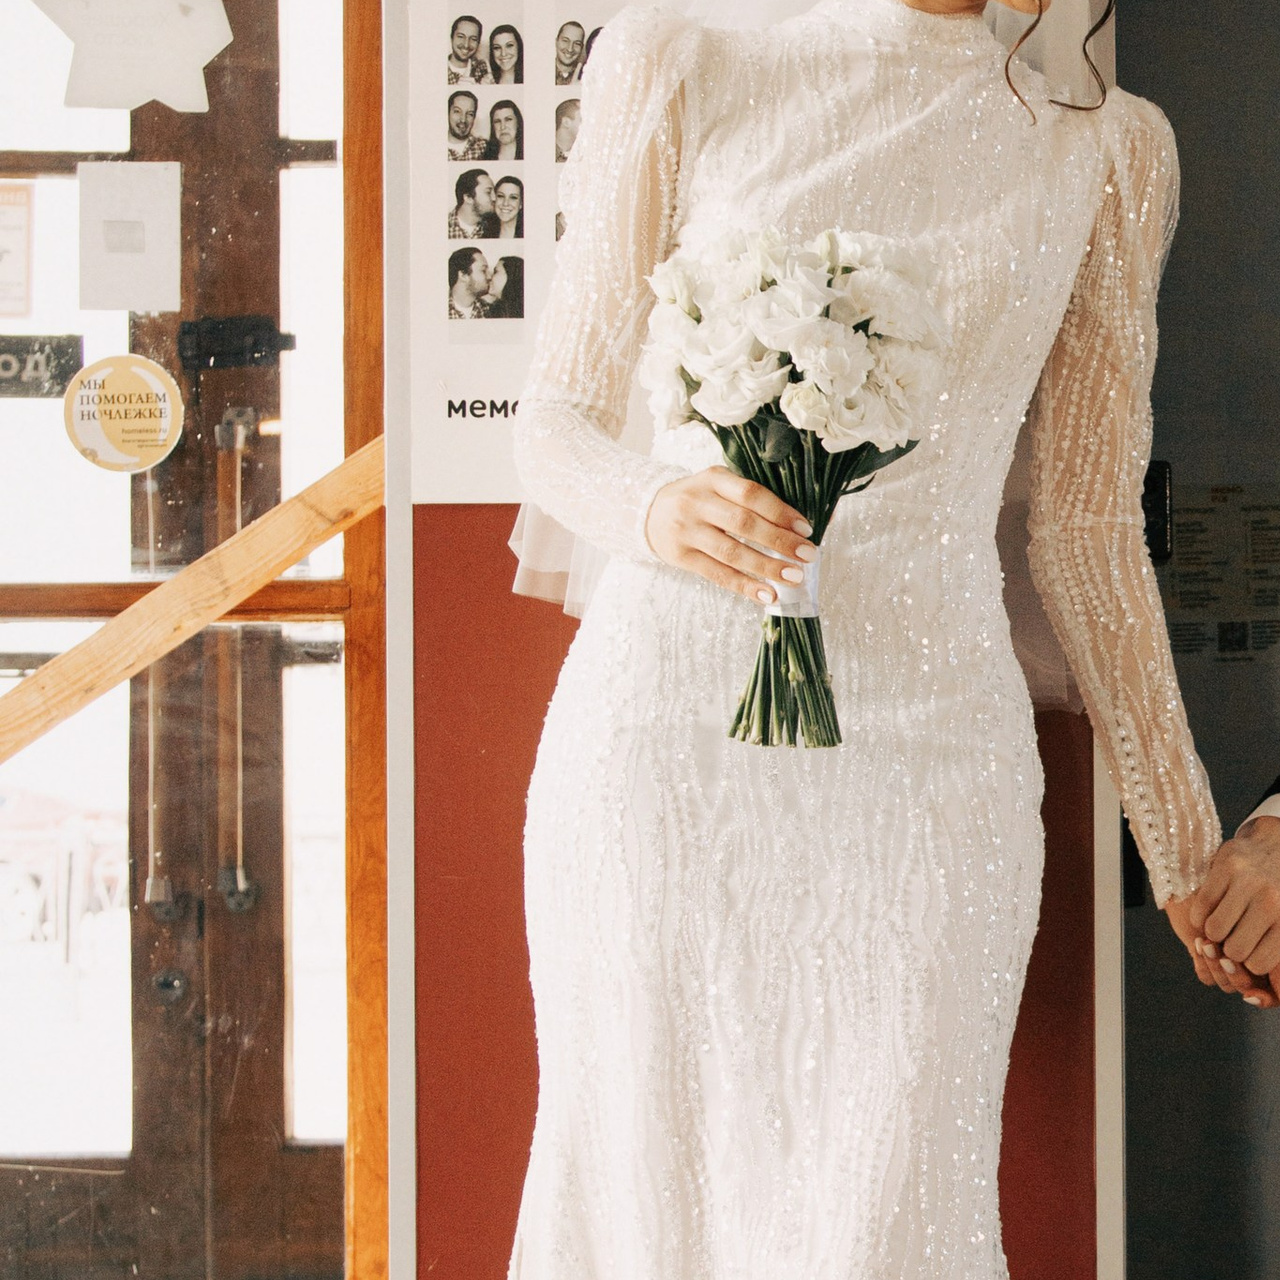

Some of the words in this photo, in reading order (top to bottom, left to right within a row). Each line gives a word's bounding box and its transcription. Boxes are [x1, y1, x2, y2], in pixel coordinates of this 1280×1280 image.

[79, 379, 106, 391] МЫ
[79, 392, 168, 406] ПОМОГАЕМ
[80, 407, 168, 422] НОЧЛЕЖКЕ
